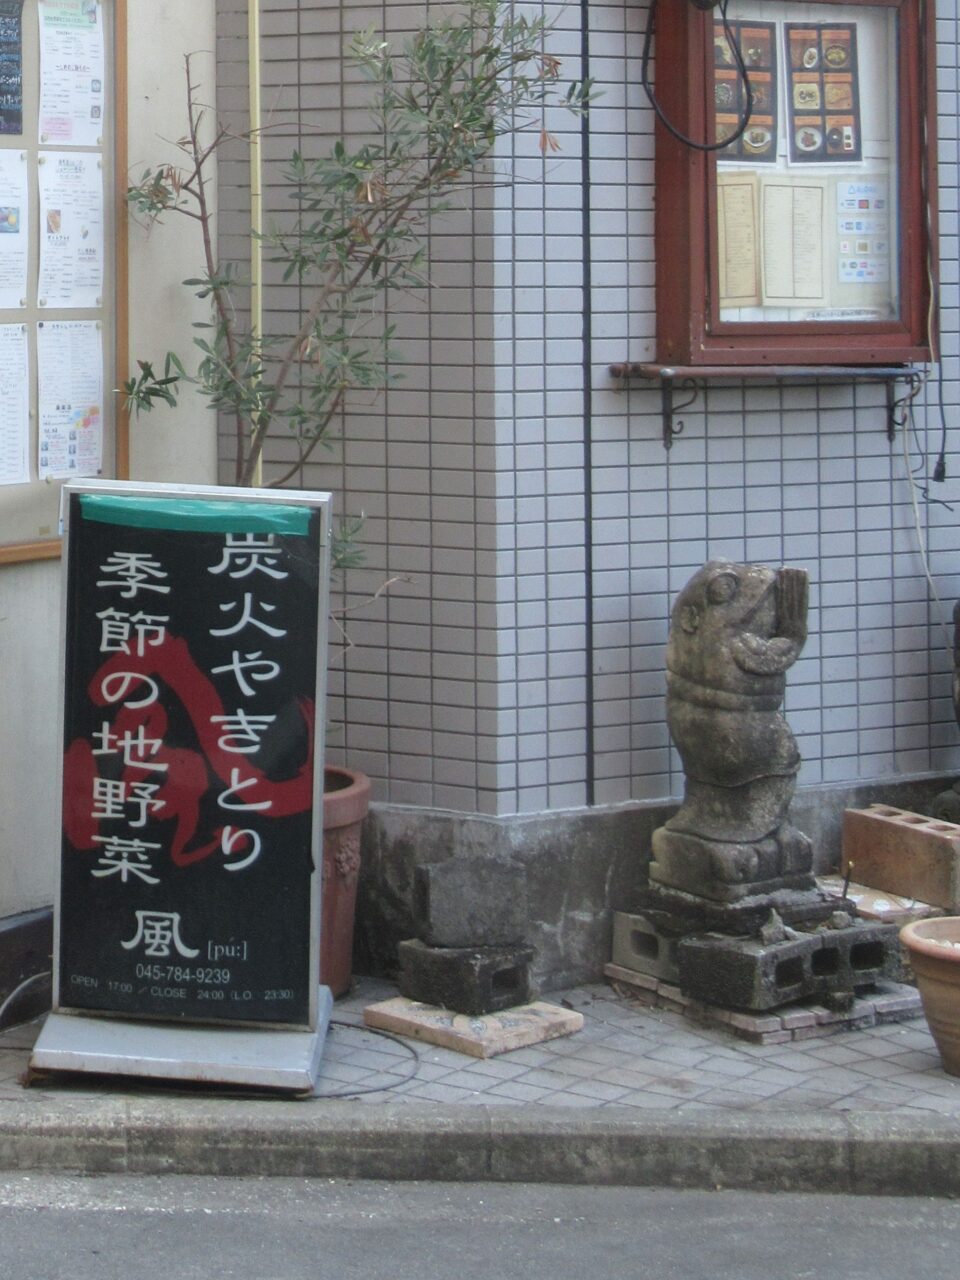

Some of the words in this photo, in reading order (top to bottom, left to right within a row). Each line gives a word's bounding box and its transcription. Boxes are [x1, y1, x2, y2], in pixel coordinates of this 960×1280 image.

[90, 551, 172, 884] 季節の地野菜
[207, 532, 289, 872] 炭火やきとり
[121, 911, 200, 958] 風
[70, 974, 99, 988] OPEN
[150, 986, 187, 999] CLOSE
[197, 988, 225, 1000] 24:00
[136, 963, 231, 984] 045-784-9239
